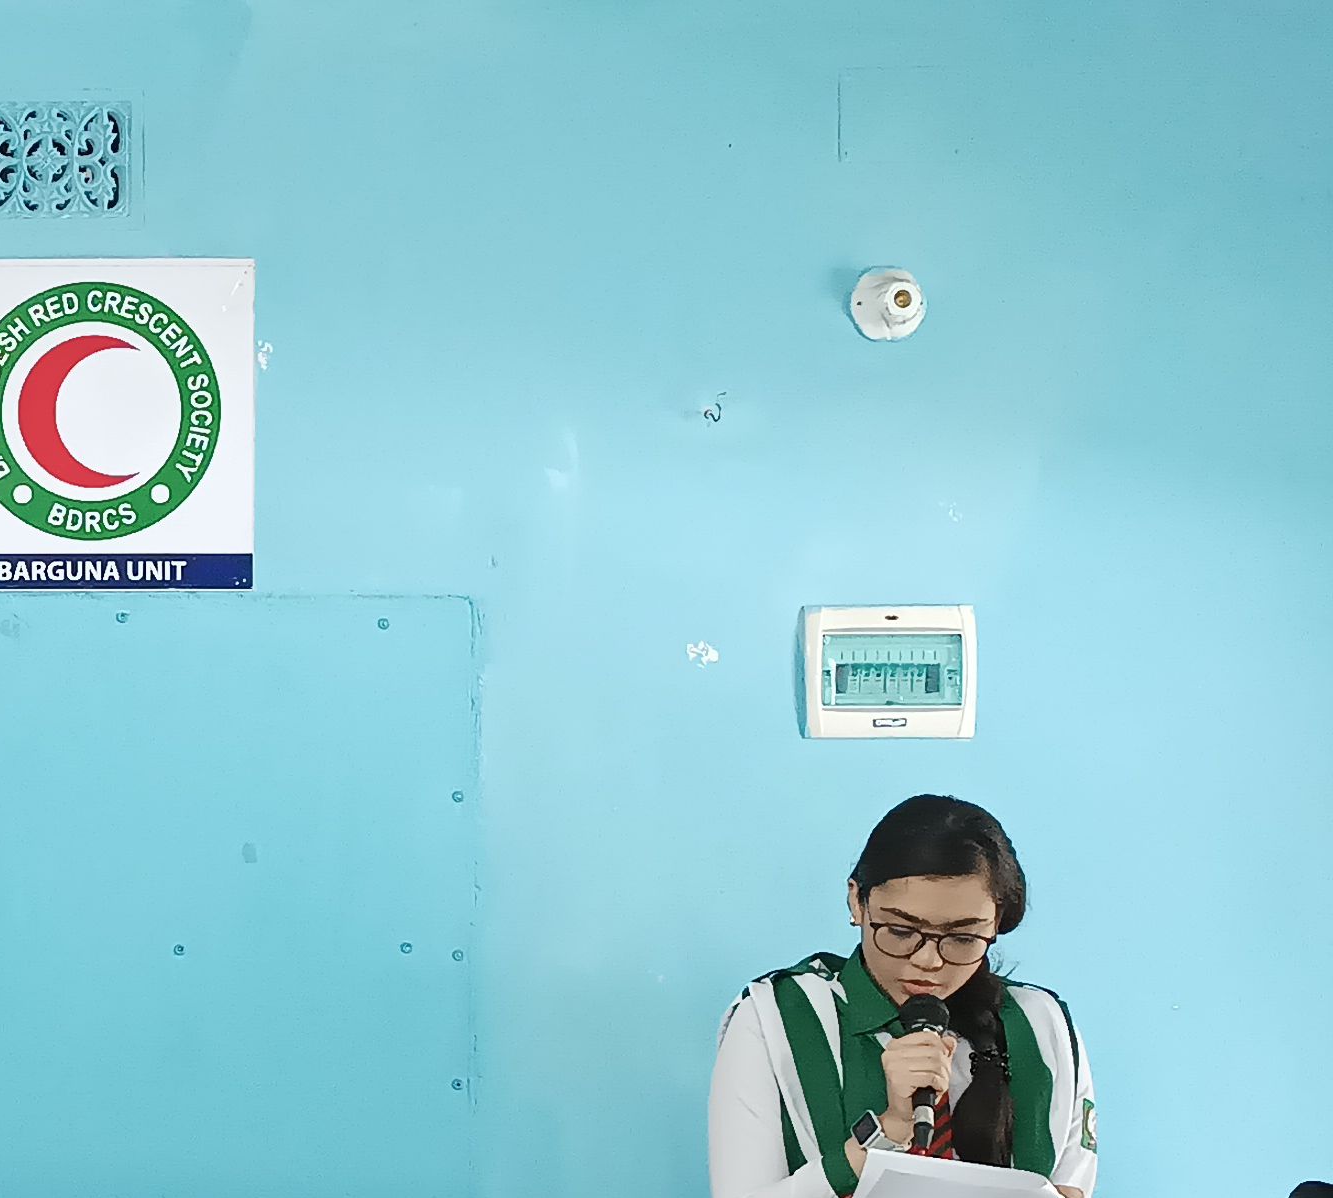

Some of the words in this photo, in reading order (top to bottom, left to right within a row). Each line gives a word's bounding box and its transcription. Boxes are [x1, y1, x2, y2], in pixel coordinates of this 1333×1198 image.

[27, 291, 79, 328] RED
[86, 290, 203, 370] CRESCENT
[174, 372, 213, 484] SOCIETY
[46, 502, 137, 533] BDRCS
[126, 560, 188, 582] UNIT
